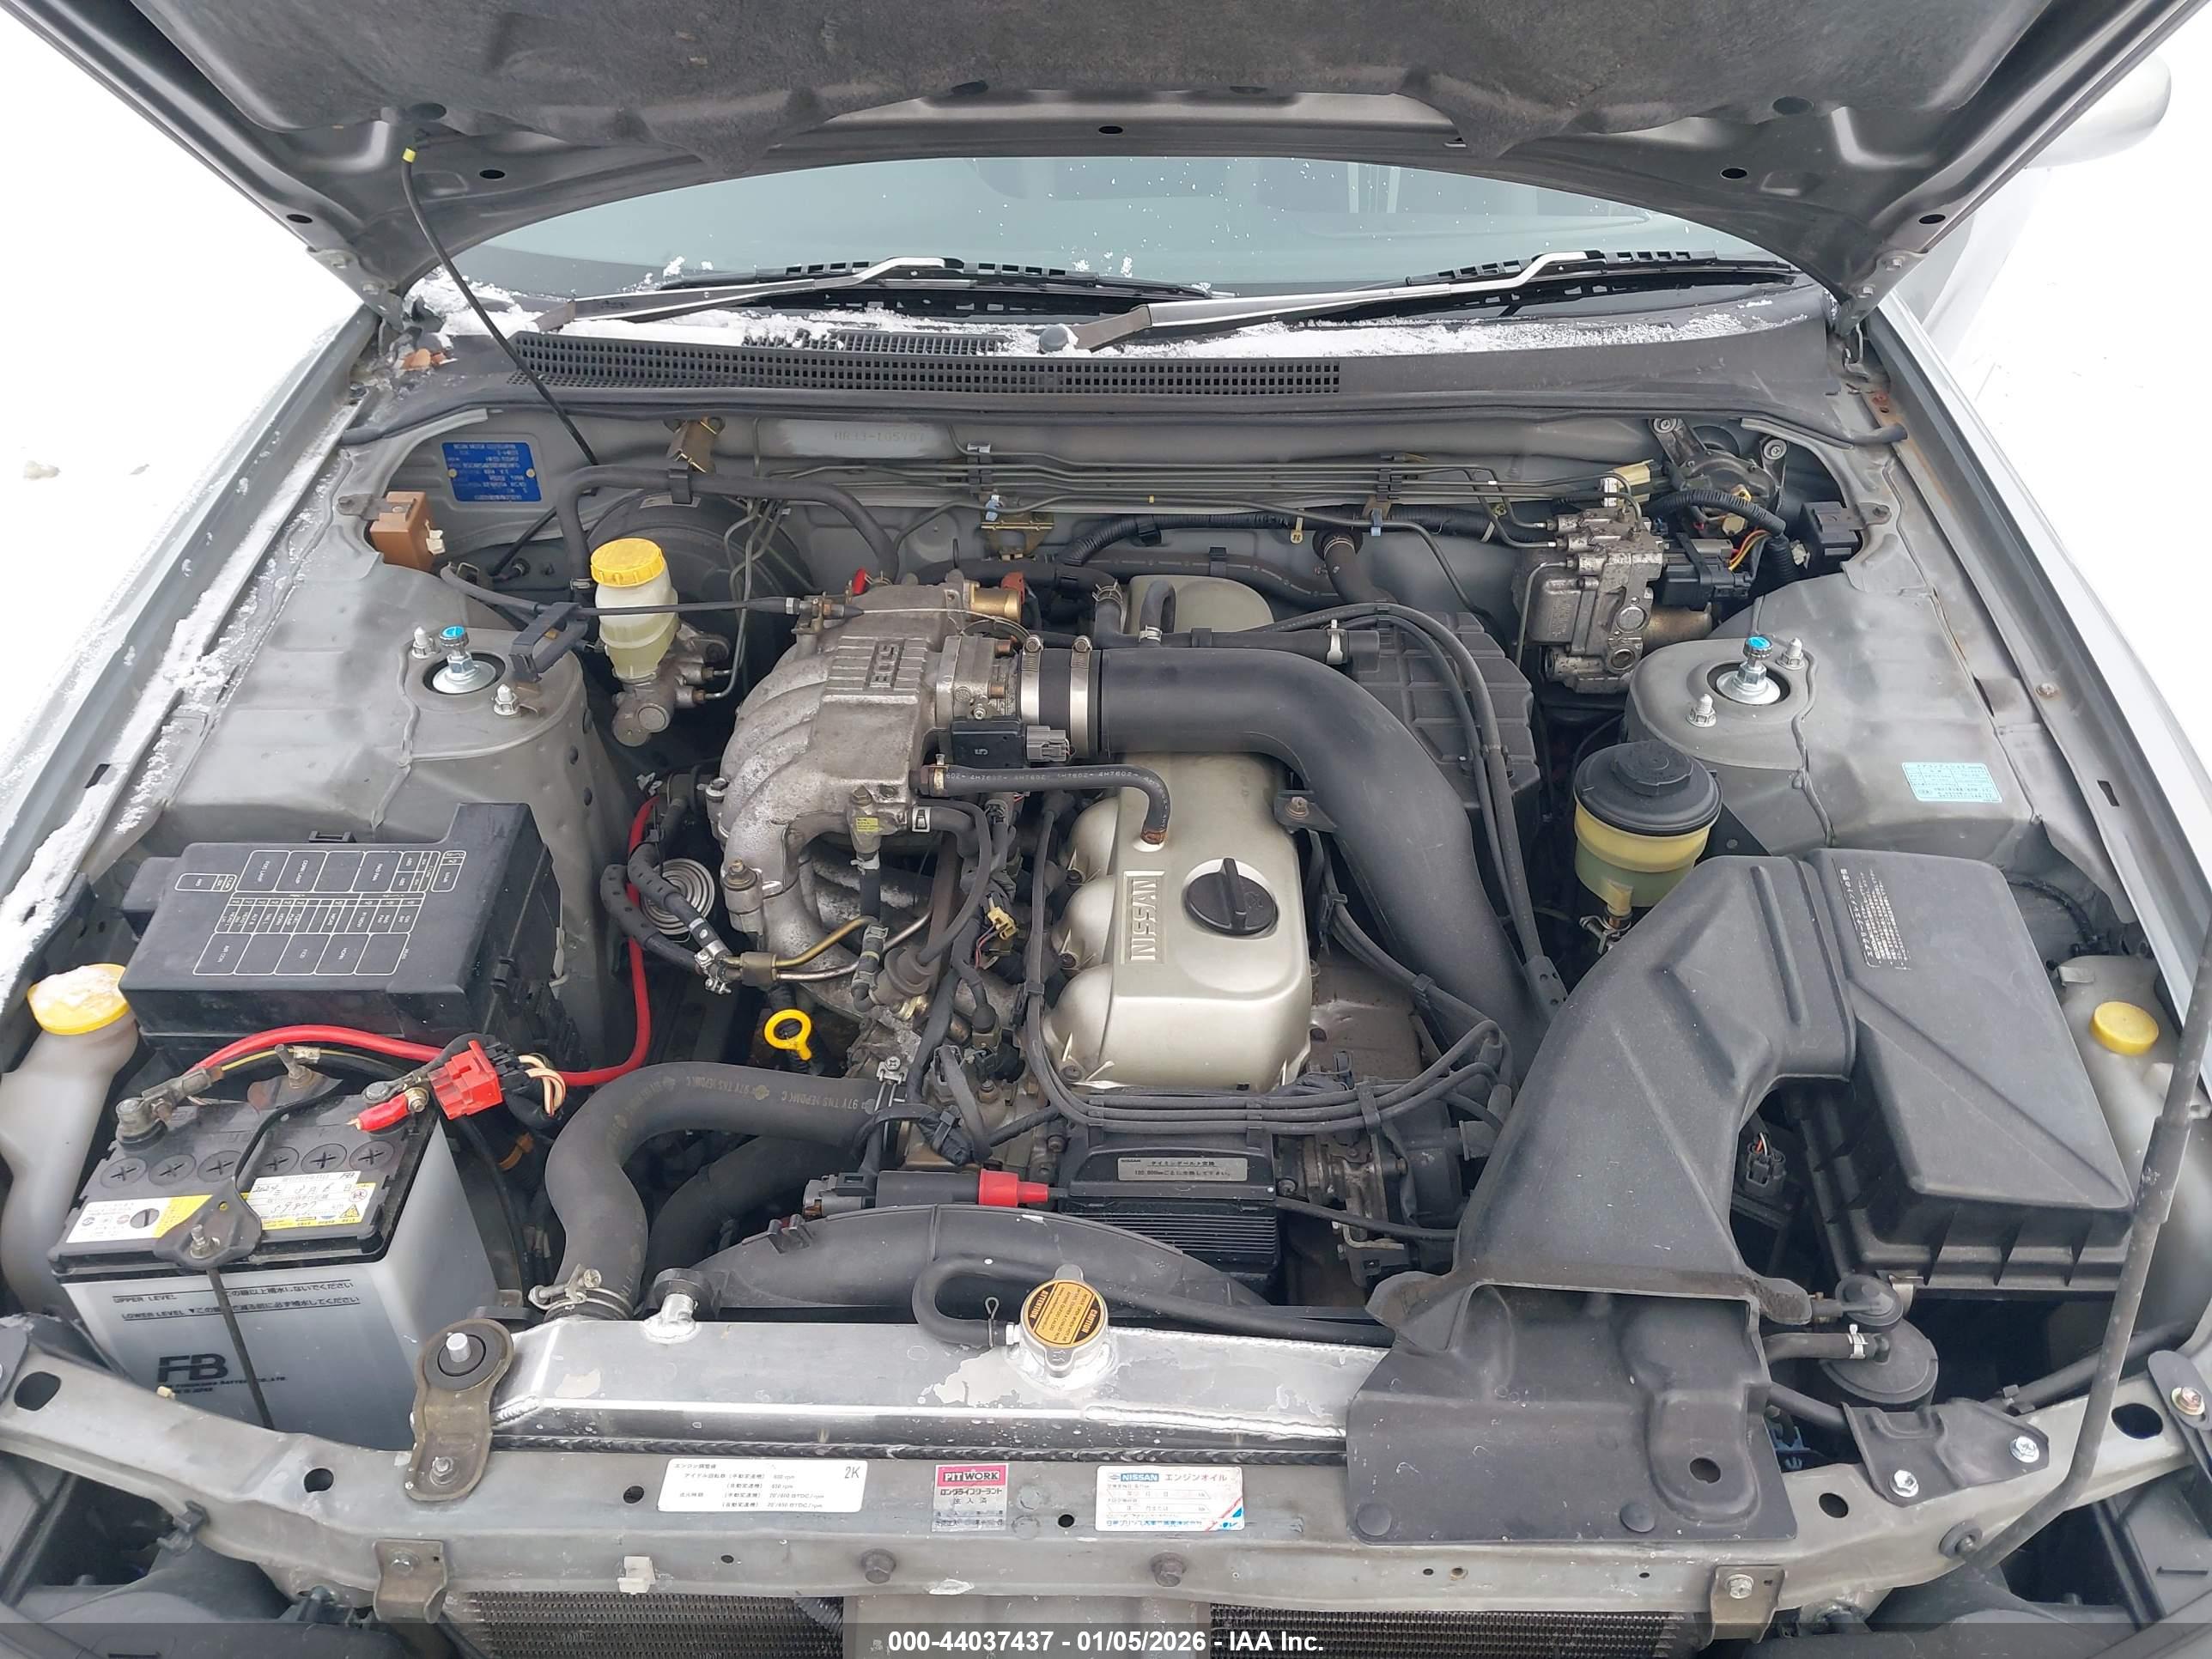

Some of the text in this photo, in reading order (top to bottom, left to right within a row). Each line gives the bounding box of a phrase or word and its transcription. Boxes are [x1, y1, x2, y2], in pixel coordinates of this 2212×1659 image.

[1130, 879, 1157, 961] NISSAN
[148, 1294, 177, 1303] LEVEL
[1030, 1290, 1049, 1320] ATTENTION
[121, 1309, 185, 1320] LOWER LEVEL
[1081, 1308, 1099, 1334] CAUTION
[157, 1352, 228, 1383] FB
[844, 1466, 860, 1479] 2K
[1164, 1474, 1228, 1482] エンジンオイル
